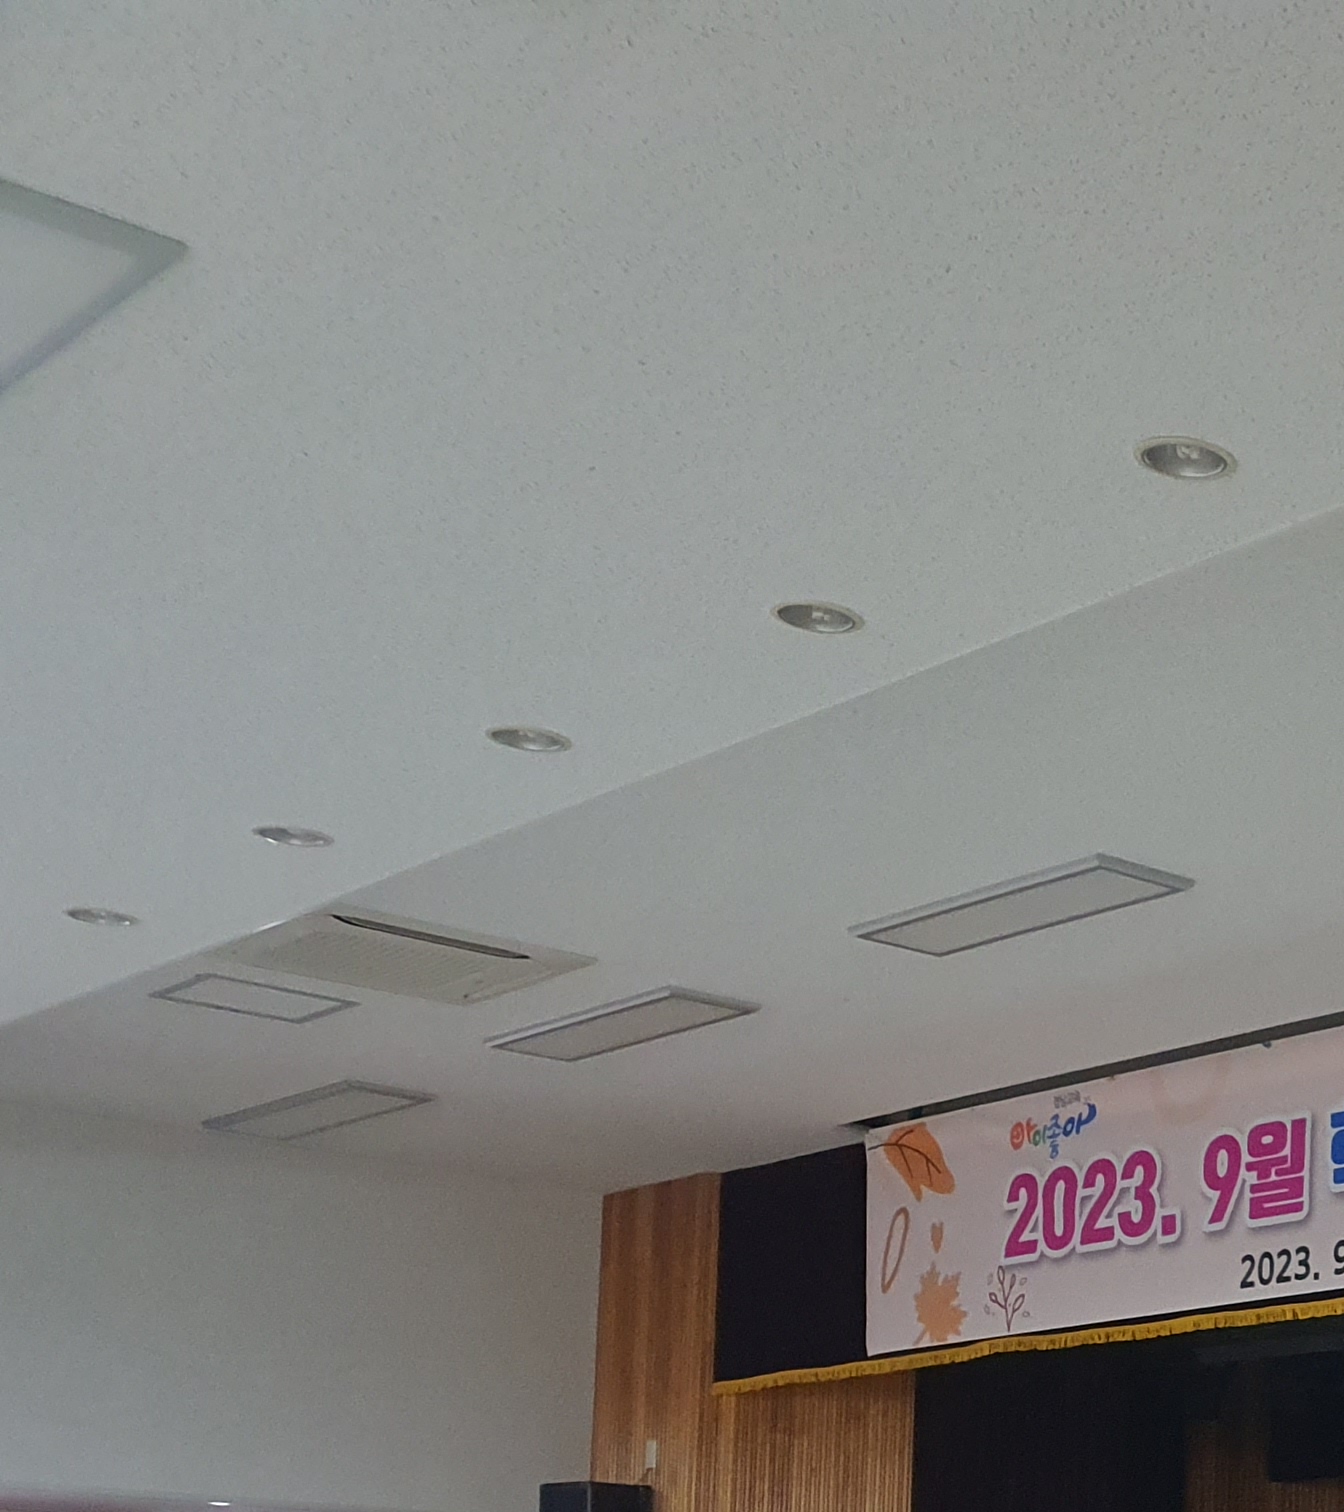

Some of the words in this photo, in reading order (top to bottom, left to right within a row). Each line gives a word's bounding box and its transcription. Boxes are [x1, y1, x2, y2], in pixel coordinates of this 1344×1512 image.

[1003, 1149, 1179, 1259] 2023.
[1202, 1115, 1309, 1225] 9월
[1240, 1246, 1320, 1289] 2023.
